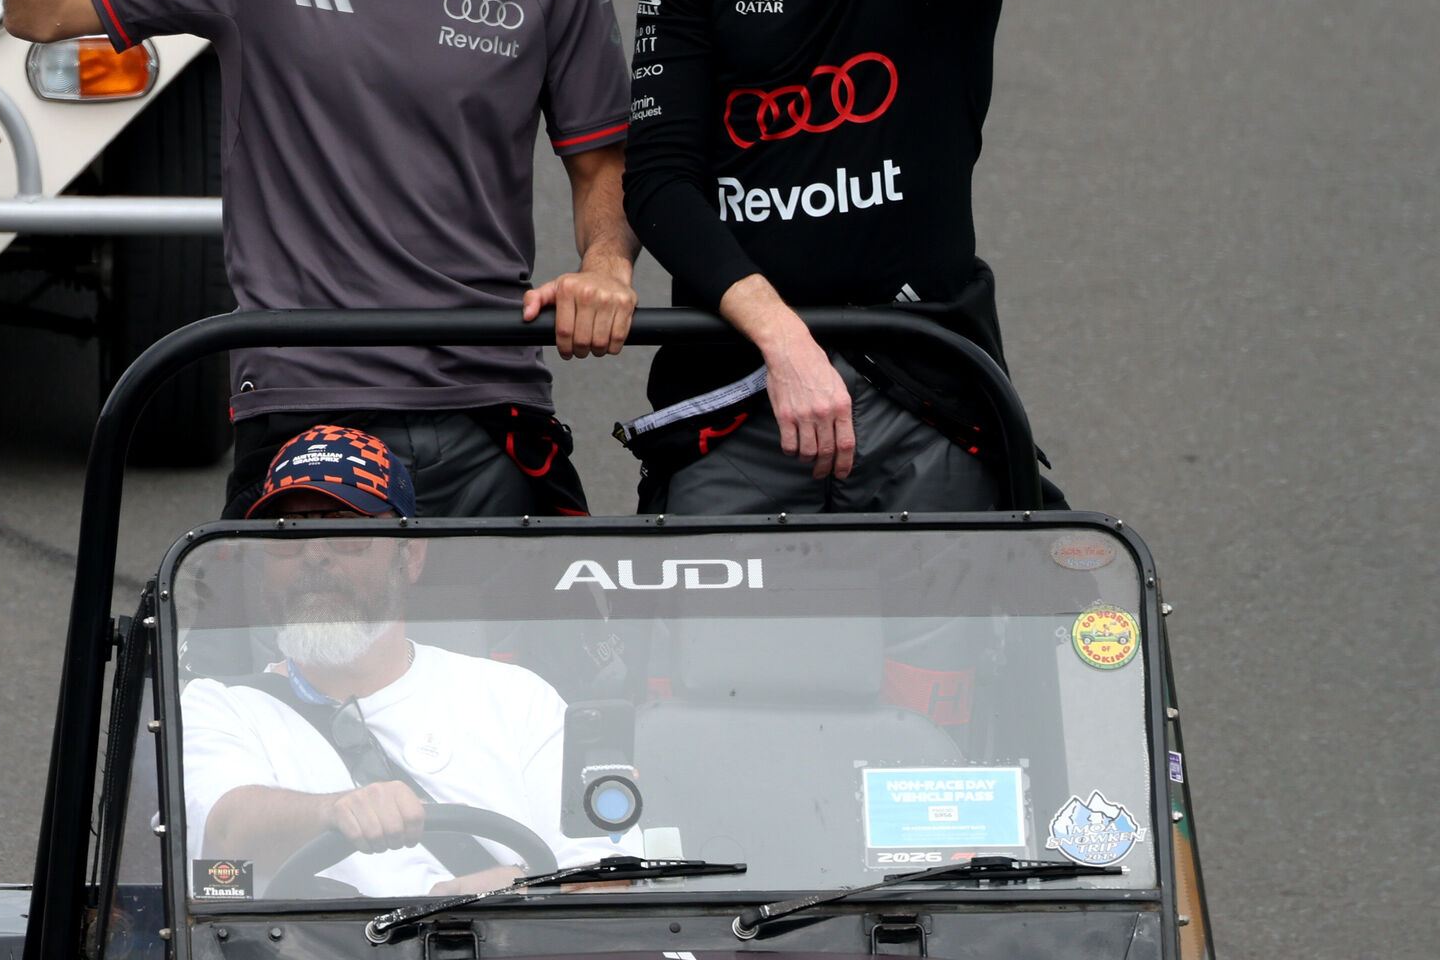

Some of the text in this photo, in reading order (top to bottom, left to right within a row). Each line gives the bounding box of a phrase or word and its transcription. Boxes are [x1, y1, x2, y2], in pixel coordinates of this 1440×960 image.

[735, 1, 784, 15] QATAR
[438, 26, 520, 59] Revolut
[717, 159, 904, 222] Revolut
[554, 559, 764, 590] AUDI
[1082, 616, 1095, 628] 60
[1083, 645, 1131, 663] MOKING
[891, 791, 995, 803] VEHICLE PASS
[1072, 822, 1118, 835] MOA
[1078, 842, 1118, 854] TRIP
[877, 852, 942, 863] 2026
[208, 868, 240, 876] PENRITE
[203, 887, 245, 896] Thanks
